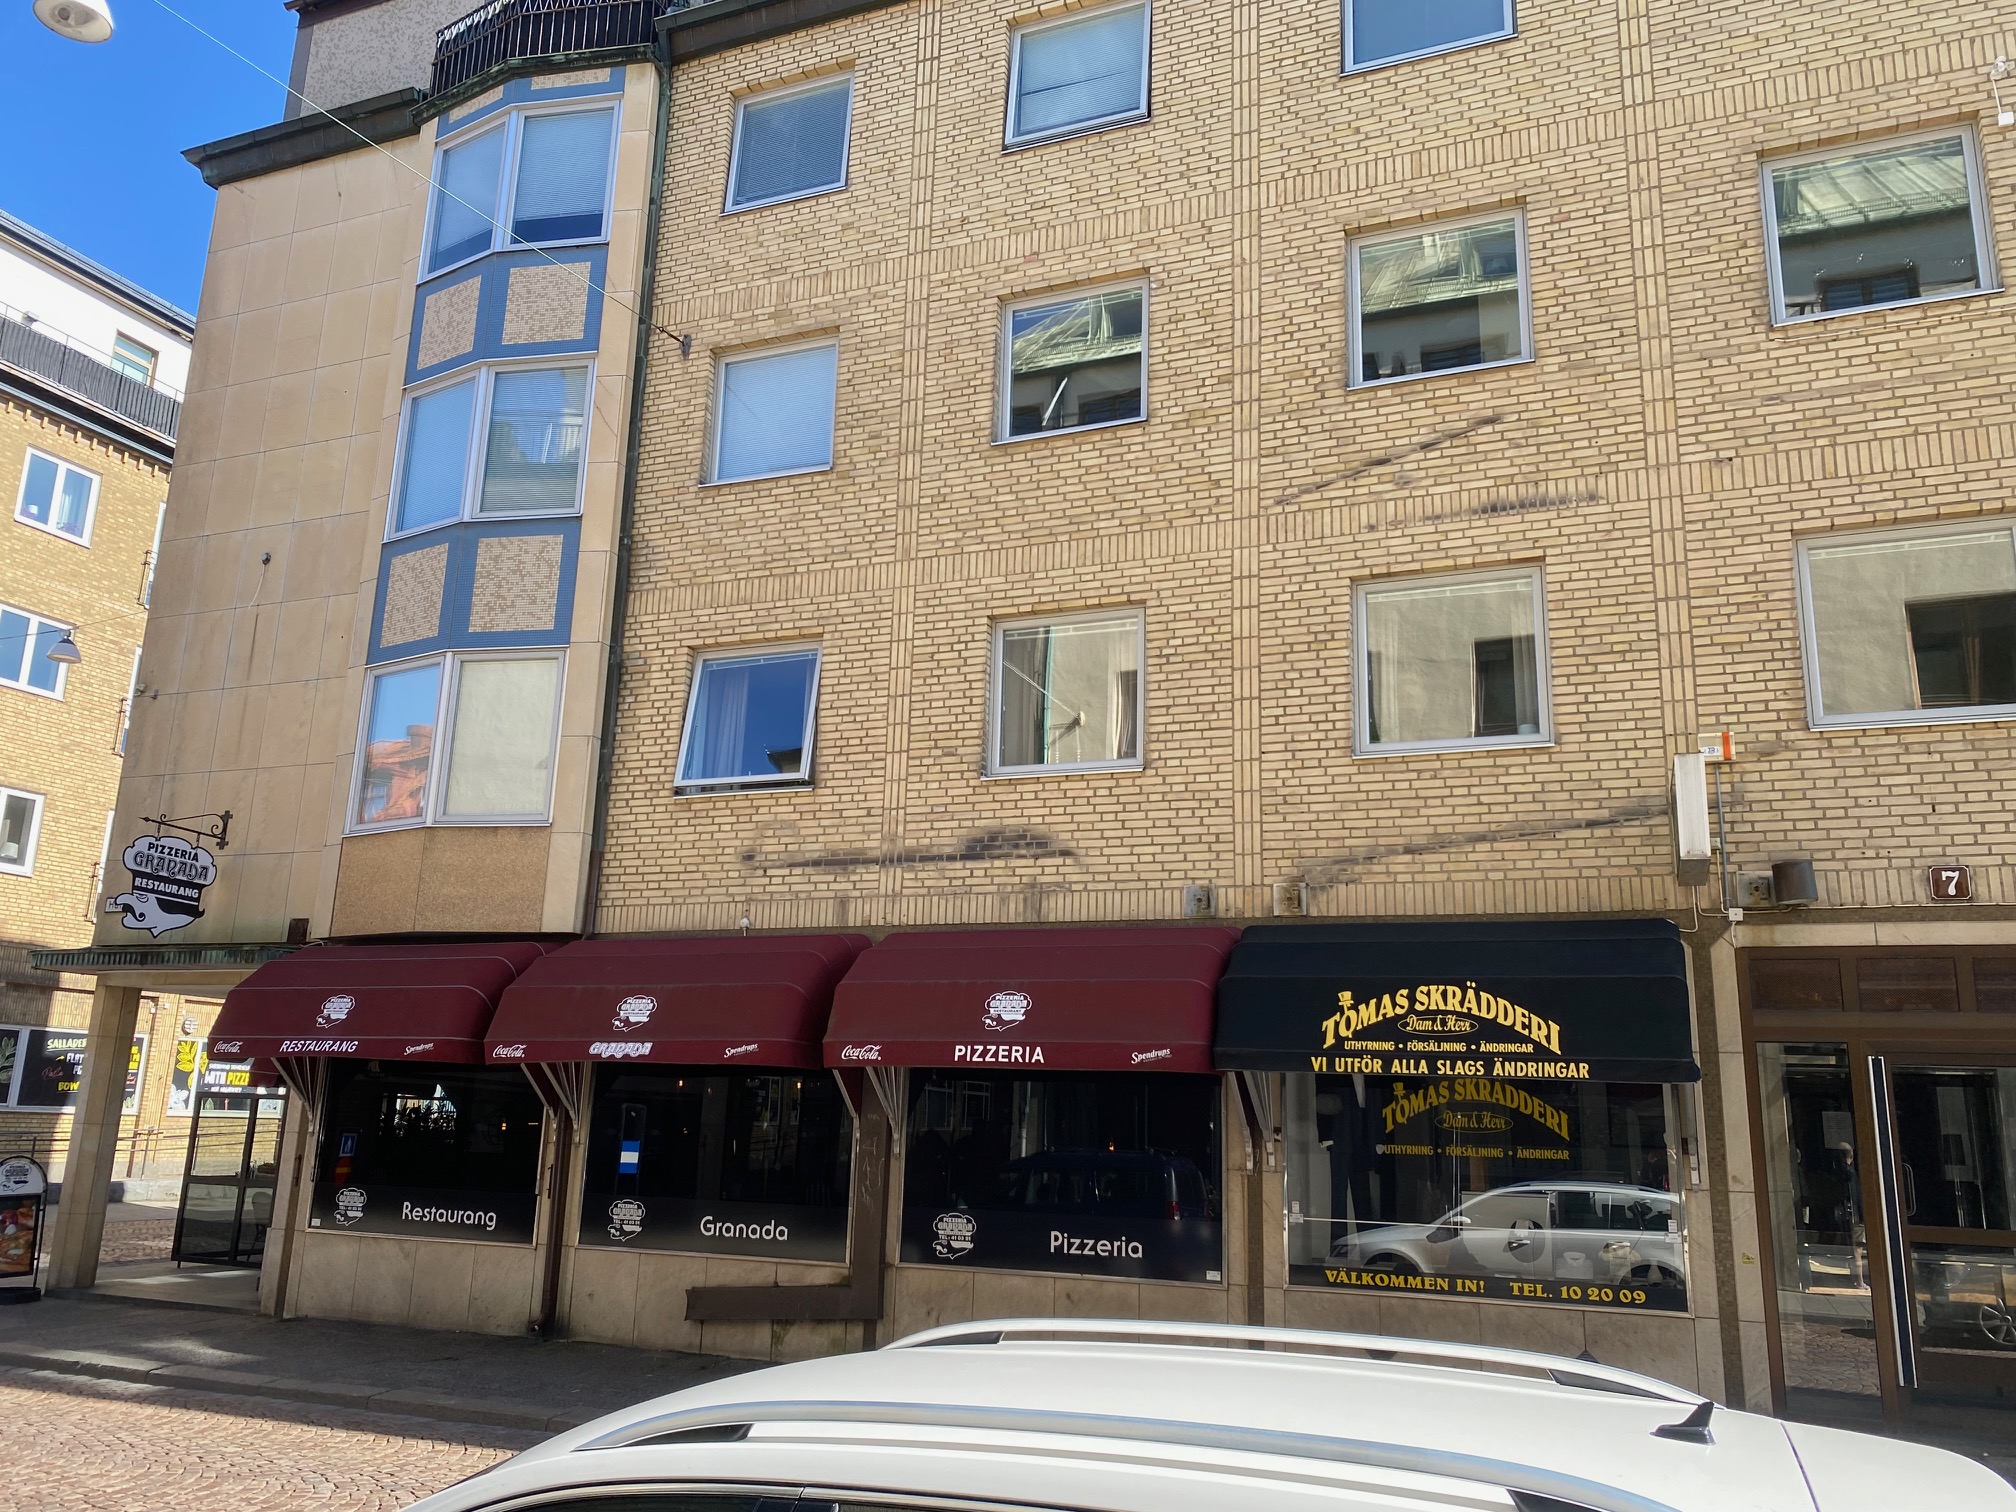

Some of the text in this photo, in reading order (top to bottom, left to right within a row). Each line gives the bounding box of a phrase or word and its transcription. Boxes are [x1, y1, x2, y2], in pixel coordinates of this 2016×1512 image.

[148, 842, 199, 862] PIZZERIA
[134, 850, 210, 882] GRANADA
[134, 878, 199, 898] RESTAURANG
[1941, 870, 1960, 896] 7
[1322, 980, 1562, 1056] TOMAS SKRÄDDERI
[1406, 1014, 1471, 1031] Dam & Herr
[279, 1040, 358, 1053] RESTAURANG
[589, 1042, 653, 1058] GRANADA
[724, 1044, 758, 1058] Spendrups
[954, 1045, 1044, 1064] PIZZERIA
[1131, 1048, 1170, 1064] Spendrups
[1344, 1040, 1534, 1053] UTHYRNING FÖRSÄLJNING ÄNDRINGAR
[1310, 1054, 1590, 1079] VI UTFÖR ALLA SLAGS ÄNDRINGAR
[204, 1070, 226, 1084] WITH
[1382, 1081, 1450, 1134] TOMAS
[1443, 1110, 1468, 1128] Dam
[1480, 1111, 1506, 1129] Herr
[1384, 1144, 1570, 1160] UTHYRNING FÖRSÄLJNING ÄNDRINGAR
[402, 1202, 496, 1230] Restaurang
[700, 1216, 788, 1240] Granada
[1050, 1230, 1142, 1258] Pizzeria
[1325, 1268, 1646, 1304] VÄLKOMMEN IN! TEL. 10 20 09
